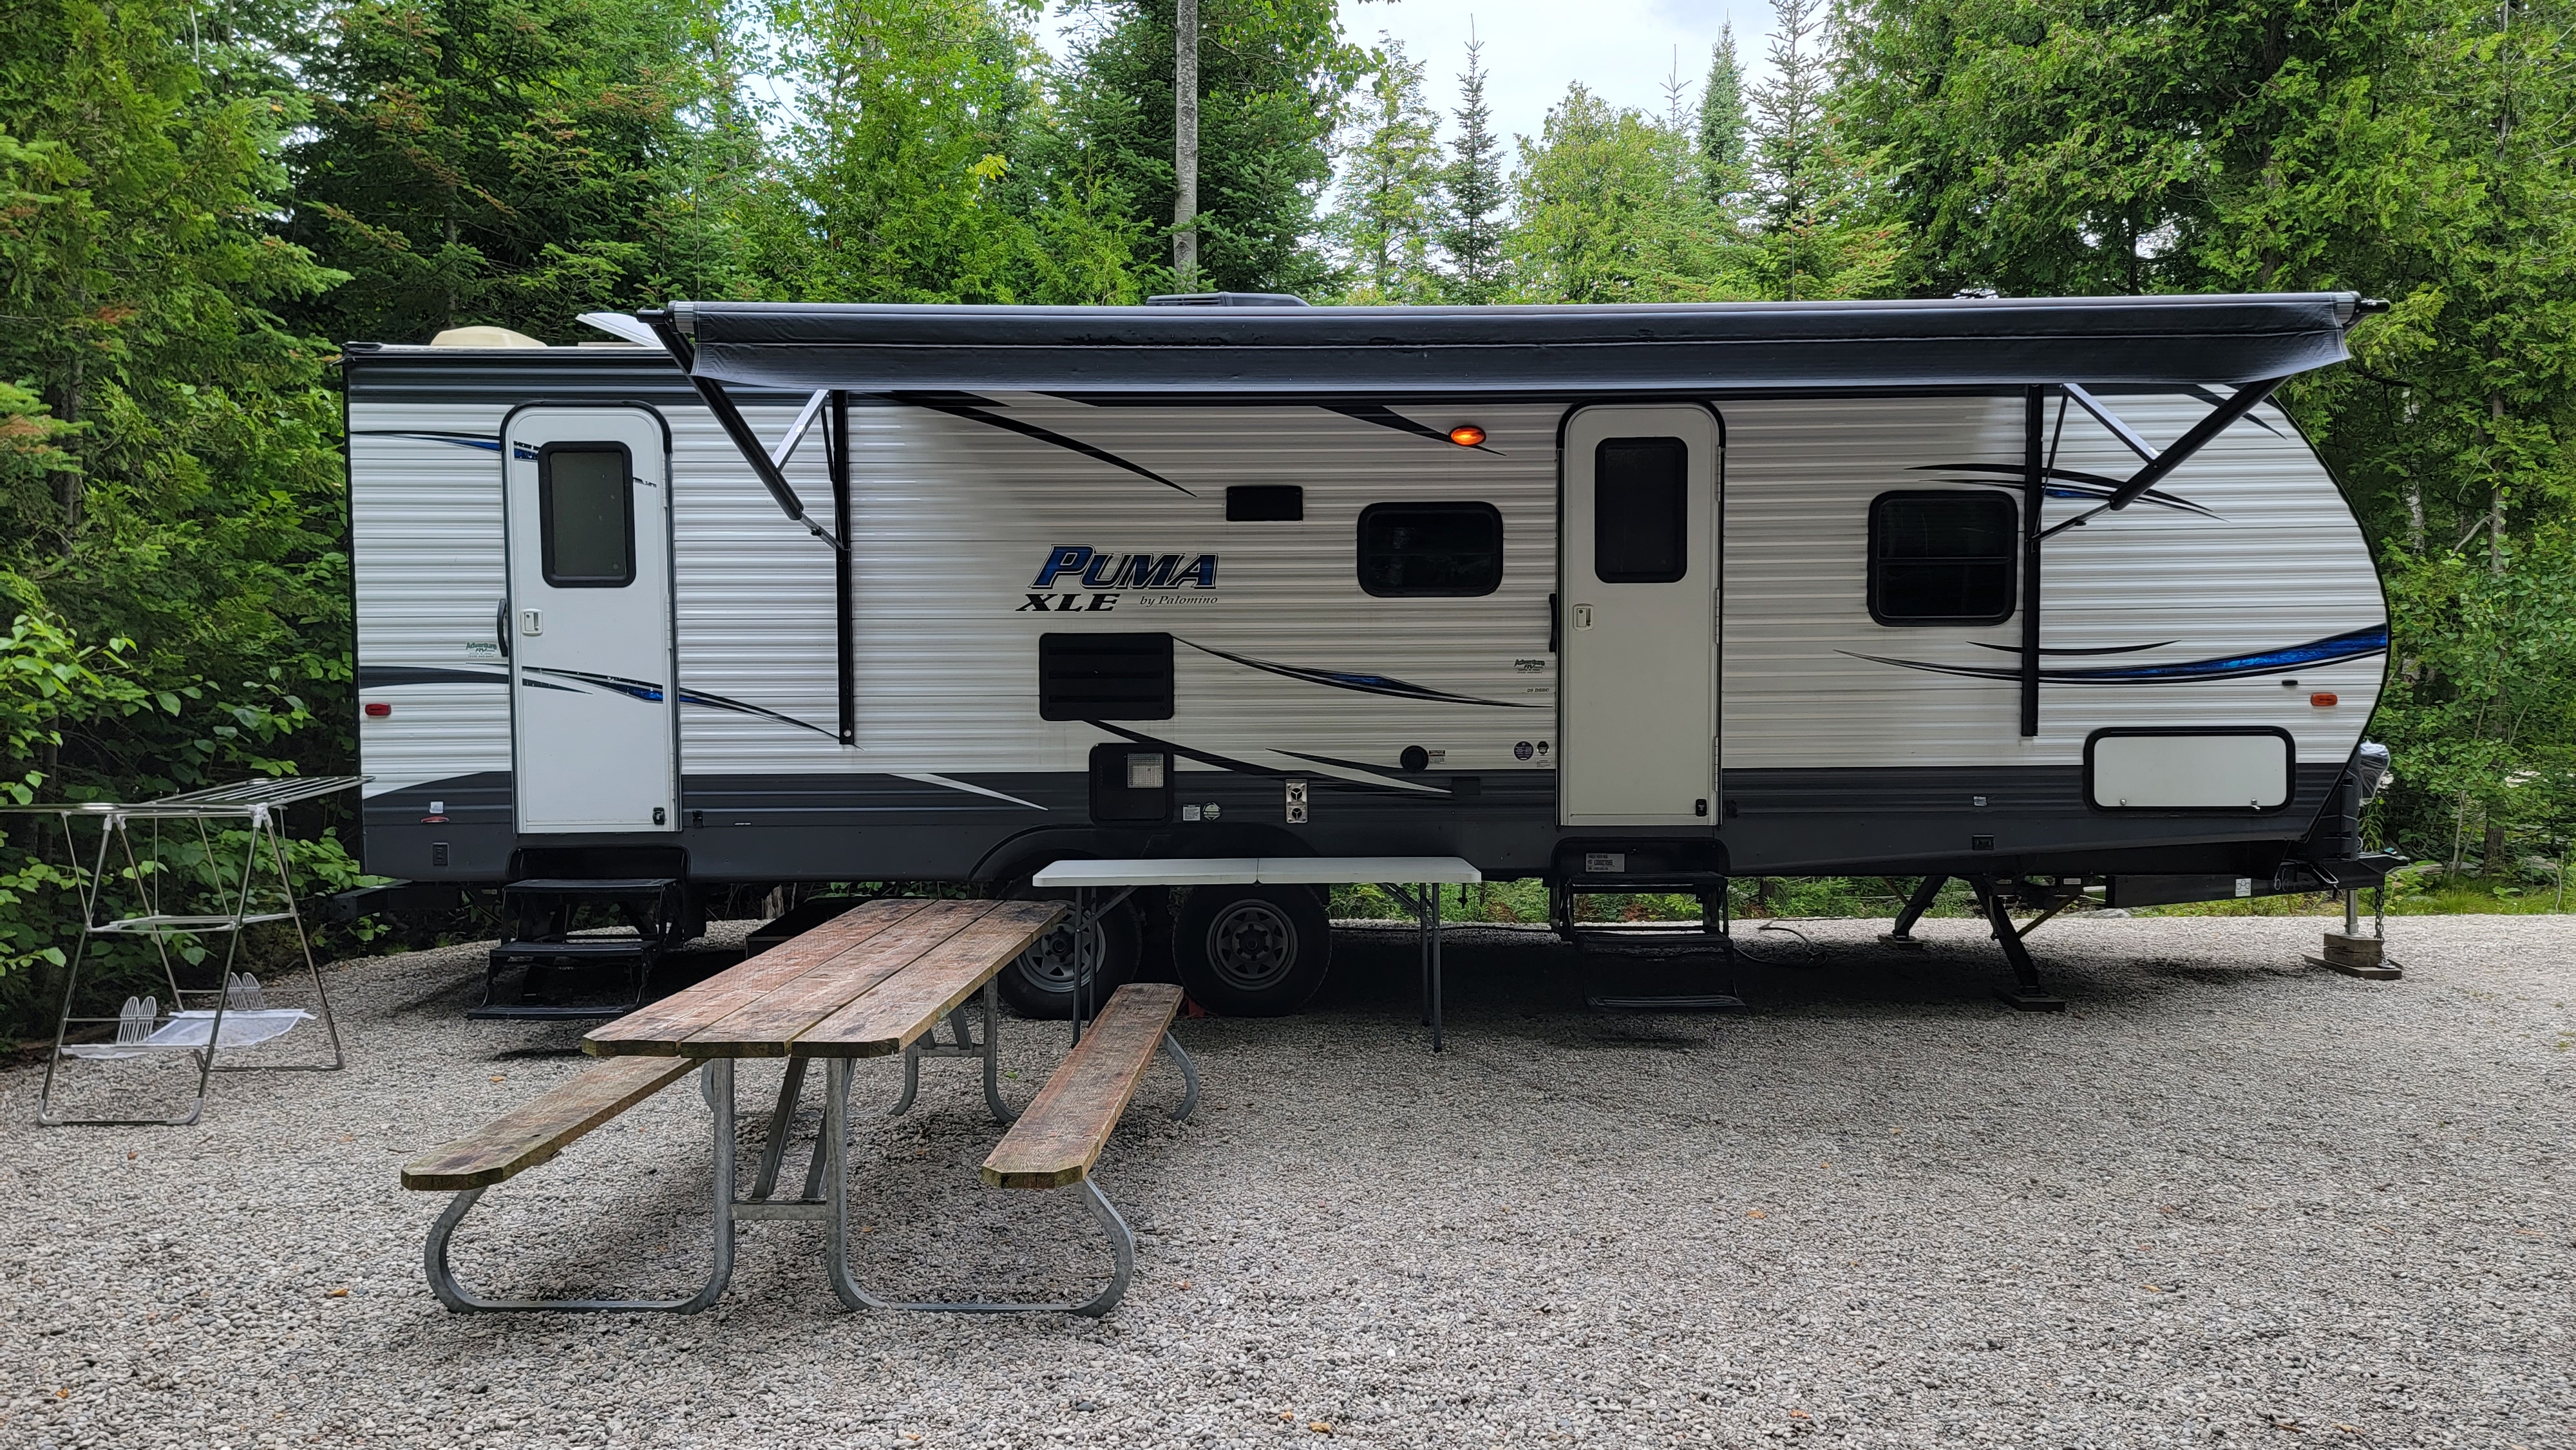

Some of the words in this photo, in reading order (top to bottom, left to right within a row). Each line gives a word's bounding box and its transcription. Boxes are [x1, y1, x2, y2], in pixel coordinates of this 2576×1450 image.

[1027, 544, 1219, 589] PUMA
[1015, 593, 1121, 612] XLE
[1139, 595, 1155, 607] by
[1159, 594, 1218, 605] Palomino
[466, 642, 497, 650] Adventure
